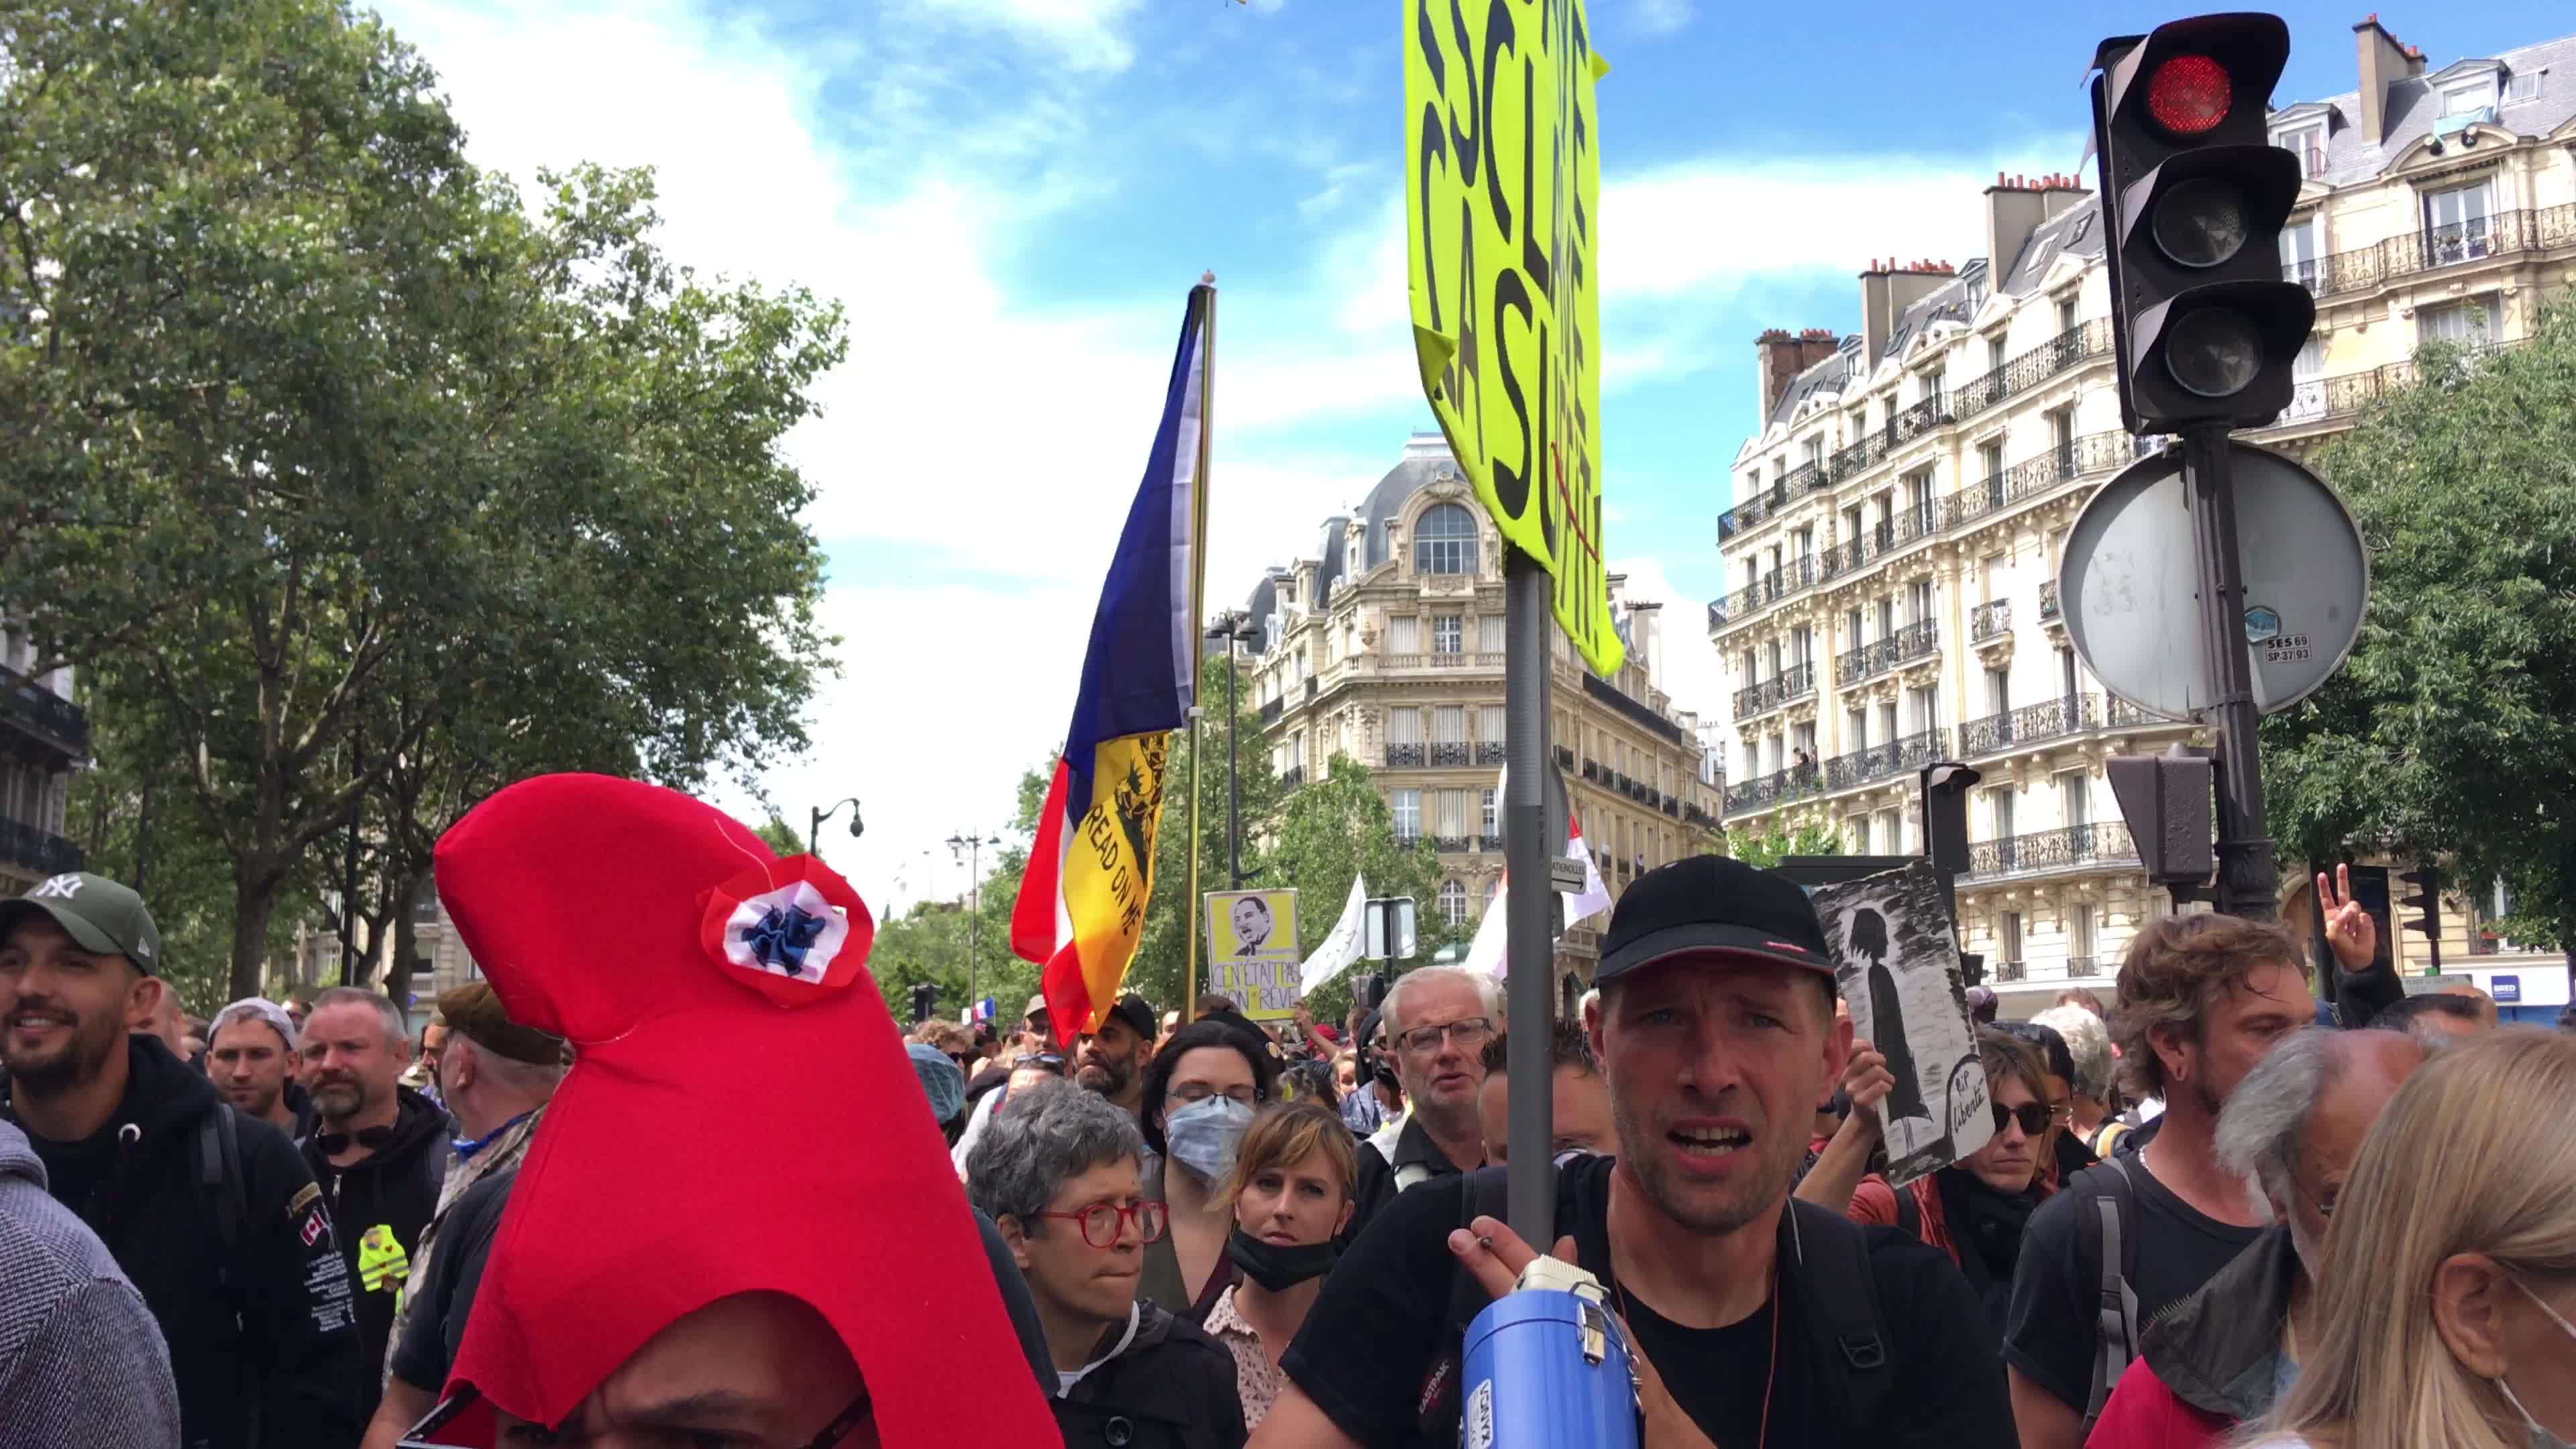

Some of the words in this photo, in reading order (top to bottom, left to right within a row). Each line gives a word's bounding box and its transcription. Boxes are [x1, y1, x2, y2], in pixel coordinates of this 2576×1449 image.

[2267, 637, 2292, 649] SES
[2296, 649, 2308, 659] 93
[1112, 865, 1132, 907] ON
[1418, 1360, 1450, 1415] EASTPAK
